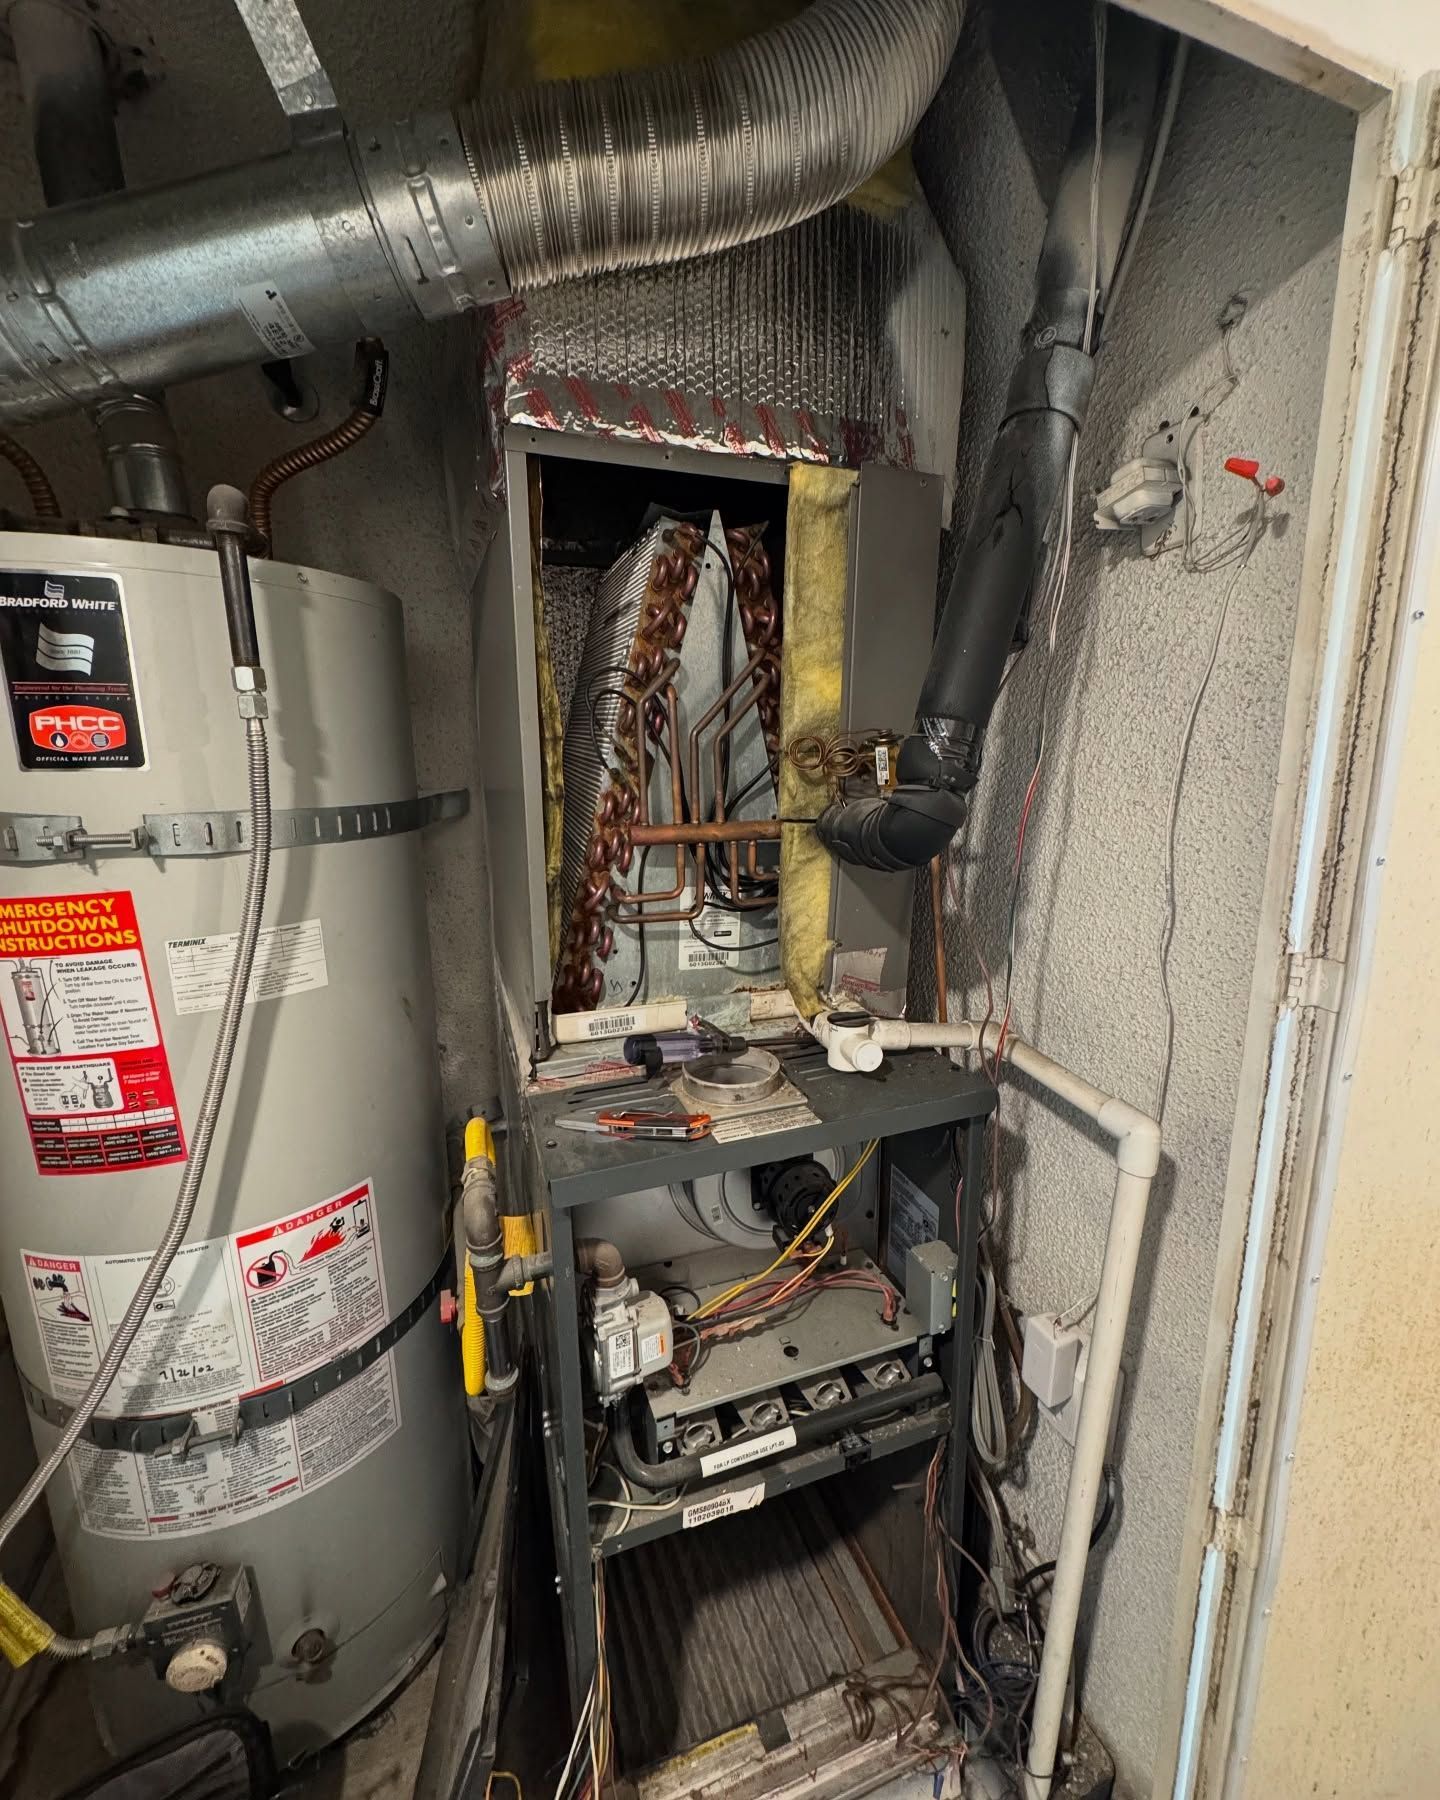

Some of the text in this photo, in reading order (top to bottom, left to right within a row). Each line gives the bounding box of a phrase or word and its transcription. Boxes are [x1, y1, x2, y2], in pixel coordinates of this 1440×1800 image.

[0, 596, 115, 610] BRADFORD WHITE
[34, 716, 120, 731] PHCC
[168, 938, 207, 949] TERMINIX
[285, 1200, 342, 1231] DANGER
[186, 1245, 209, 1254] HEATER
[37, 1260, 77, 1271] DANGER
[730, 1450, 759, 1464] CONVERSION
[760, 1446, 769, 1454] USE
